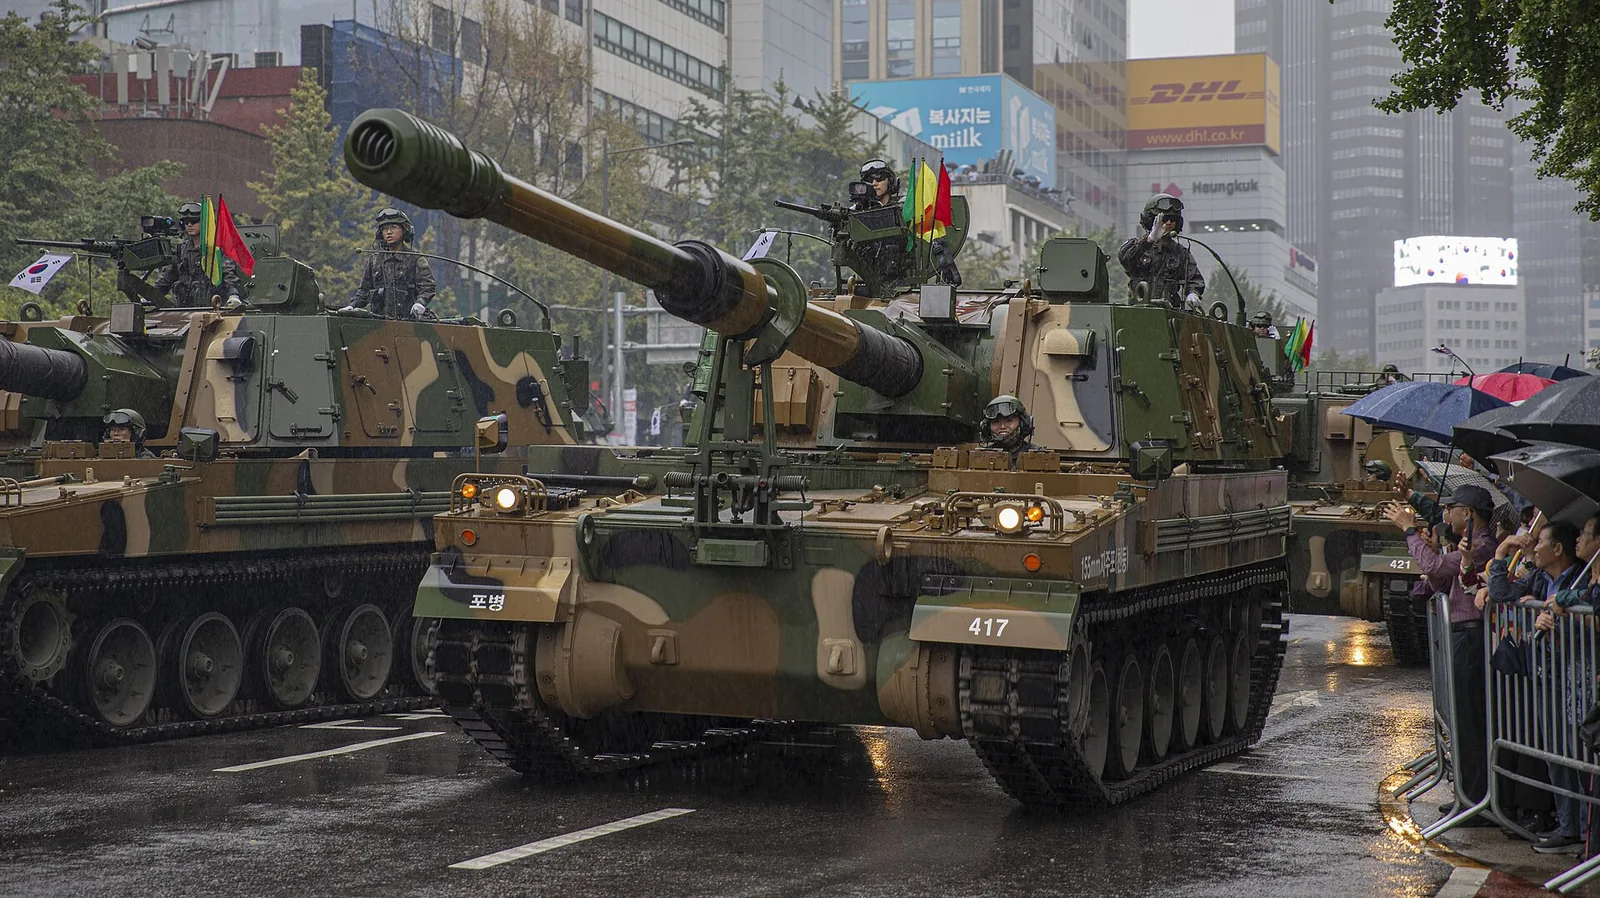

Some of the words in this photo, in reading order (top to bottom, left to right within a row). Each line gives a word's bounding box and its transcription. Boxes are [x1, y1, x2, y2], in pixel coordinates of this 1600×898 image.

[1148, 79, 1246, 104] DHL
[929, 107, 991, 126] 복사지는
[930, 126, 984, 149] miilk
[1146, 128, 1245, 145] www.dhl.co.kr
[1192, 179, 1259, 196] Heungkuk
[1389, 559, 1411, 571] 421
[468, 594, 506, 612] 포병
[968, 616, 1010, 638] 417
